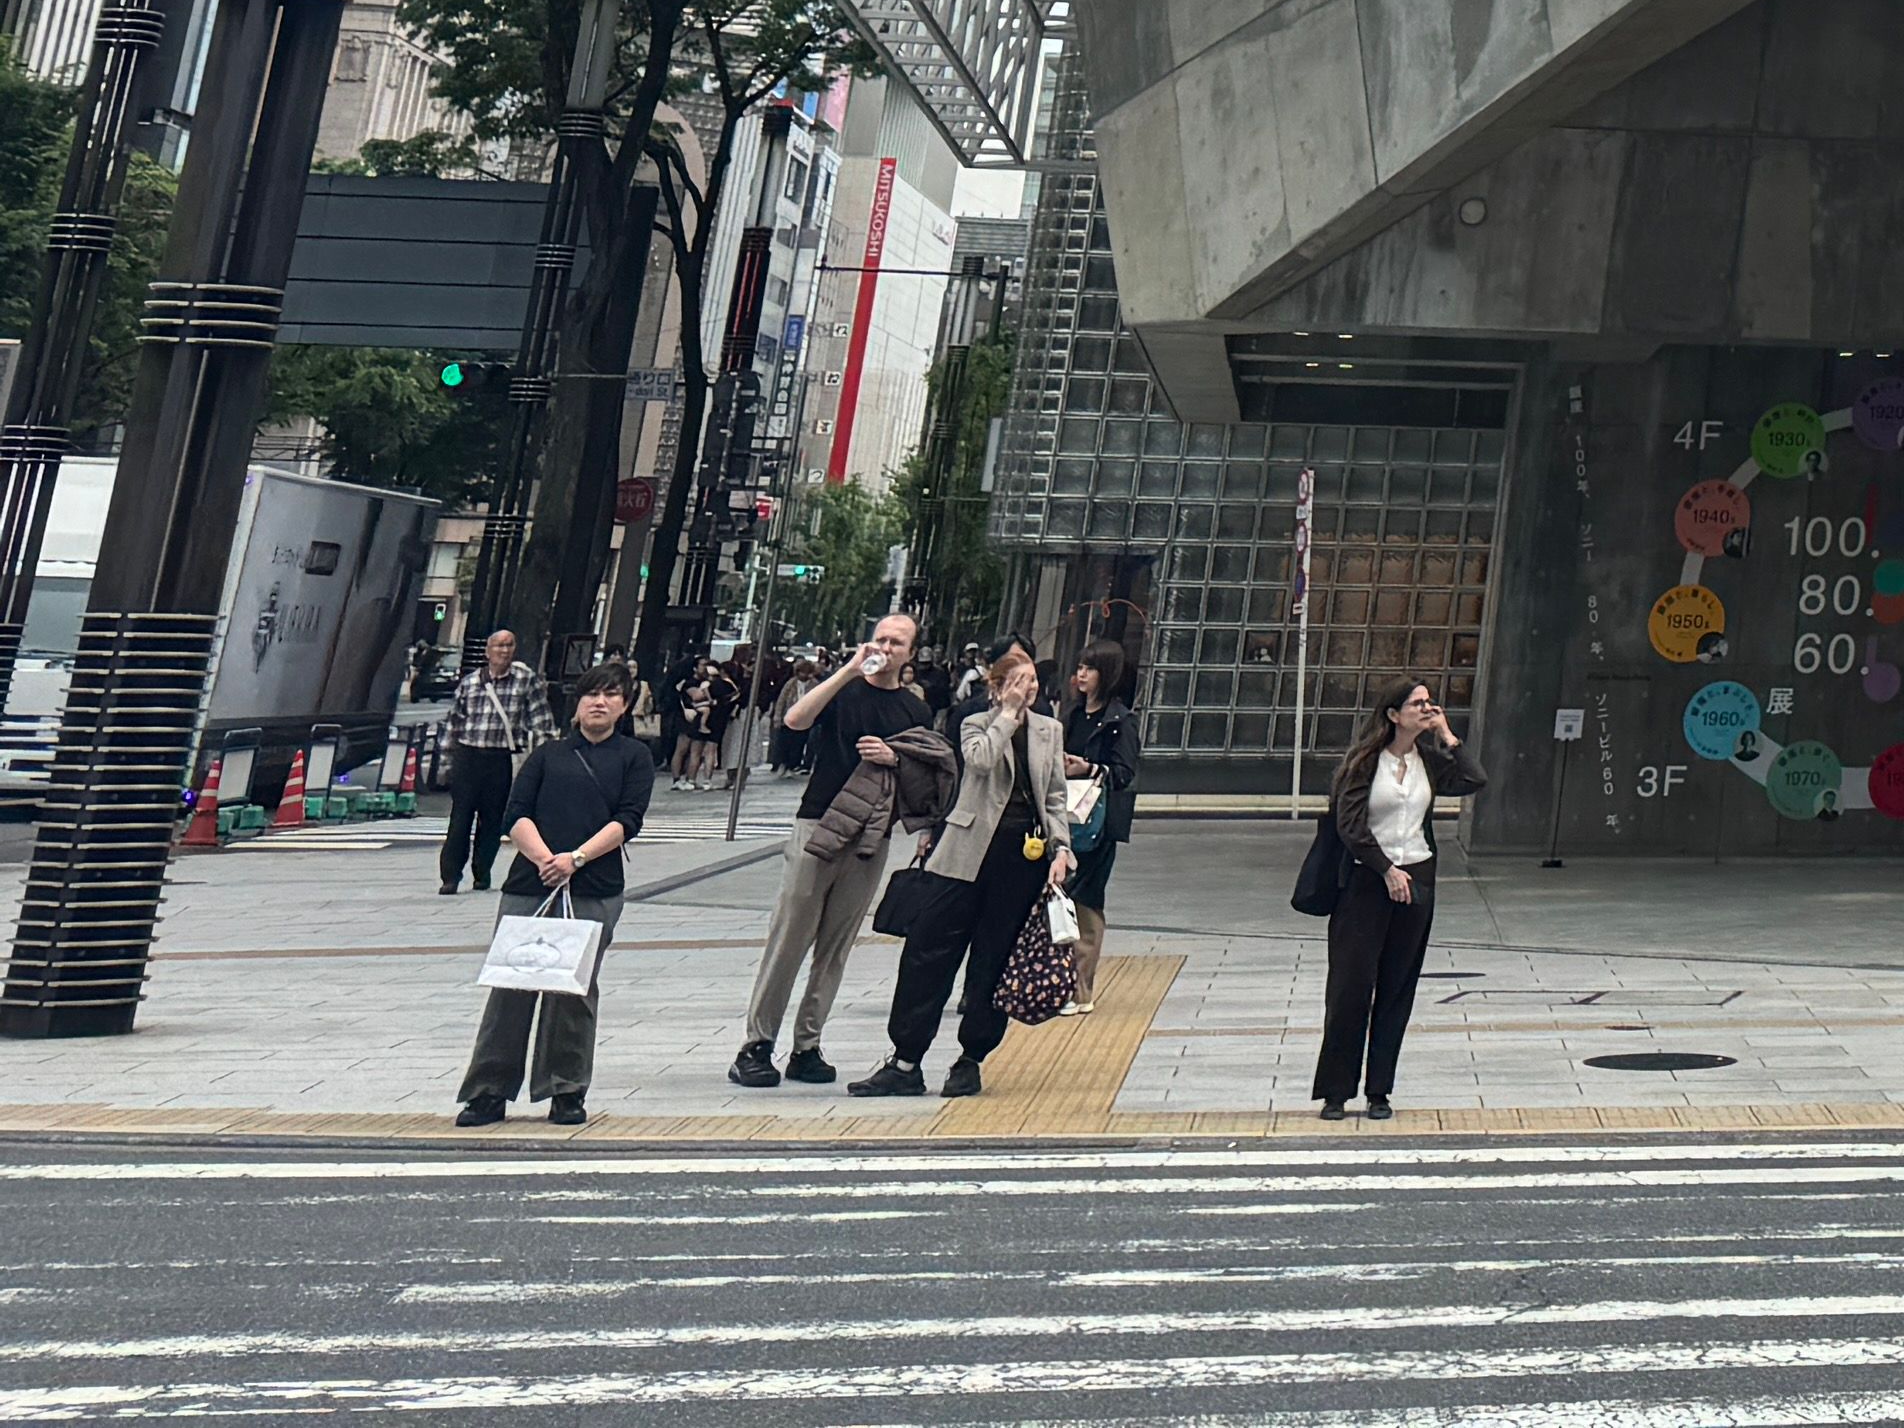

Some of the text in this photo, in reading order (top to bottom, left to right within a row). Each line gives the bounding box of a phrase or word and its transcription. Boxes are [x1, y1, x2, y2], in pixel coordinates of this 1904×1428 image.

[867, 163, 895, 258] MITSUKOSHI
[1673, 421, 1724, 451] 4F
[1784, 515, 1881, 558] 100.
[1798, 574, 1874, 616] 80.
[1793, 633, 1869, 675] 60.
[1765, 687, 1794, 715] 展
[1636, 765, 1688, 798] 3F
